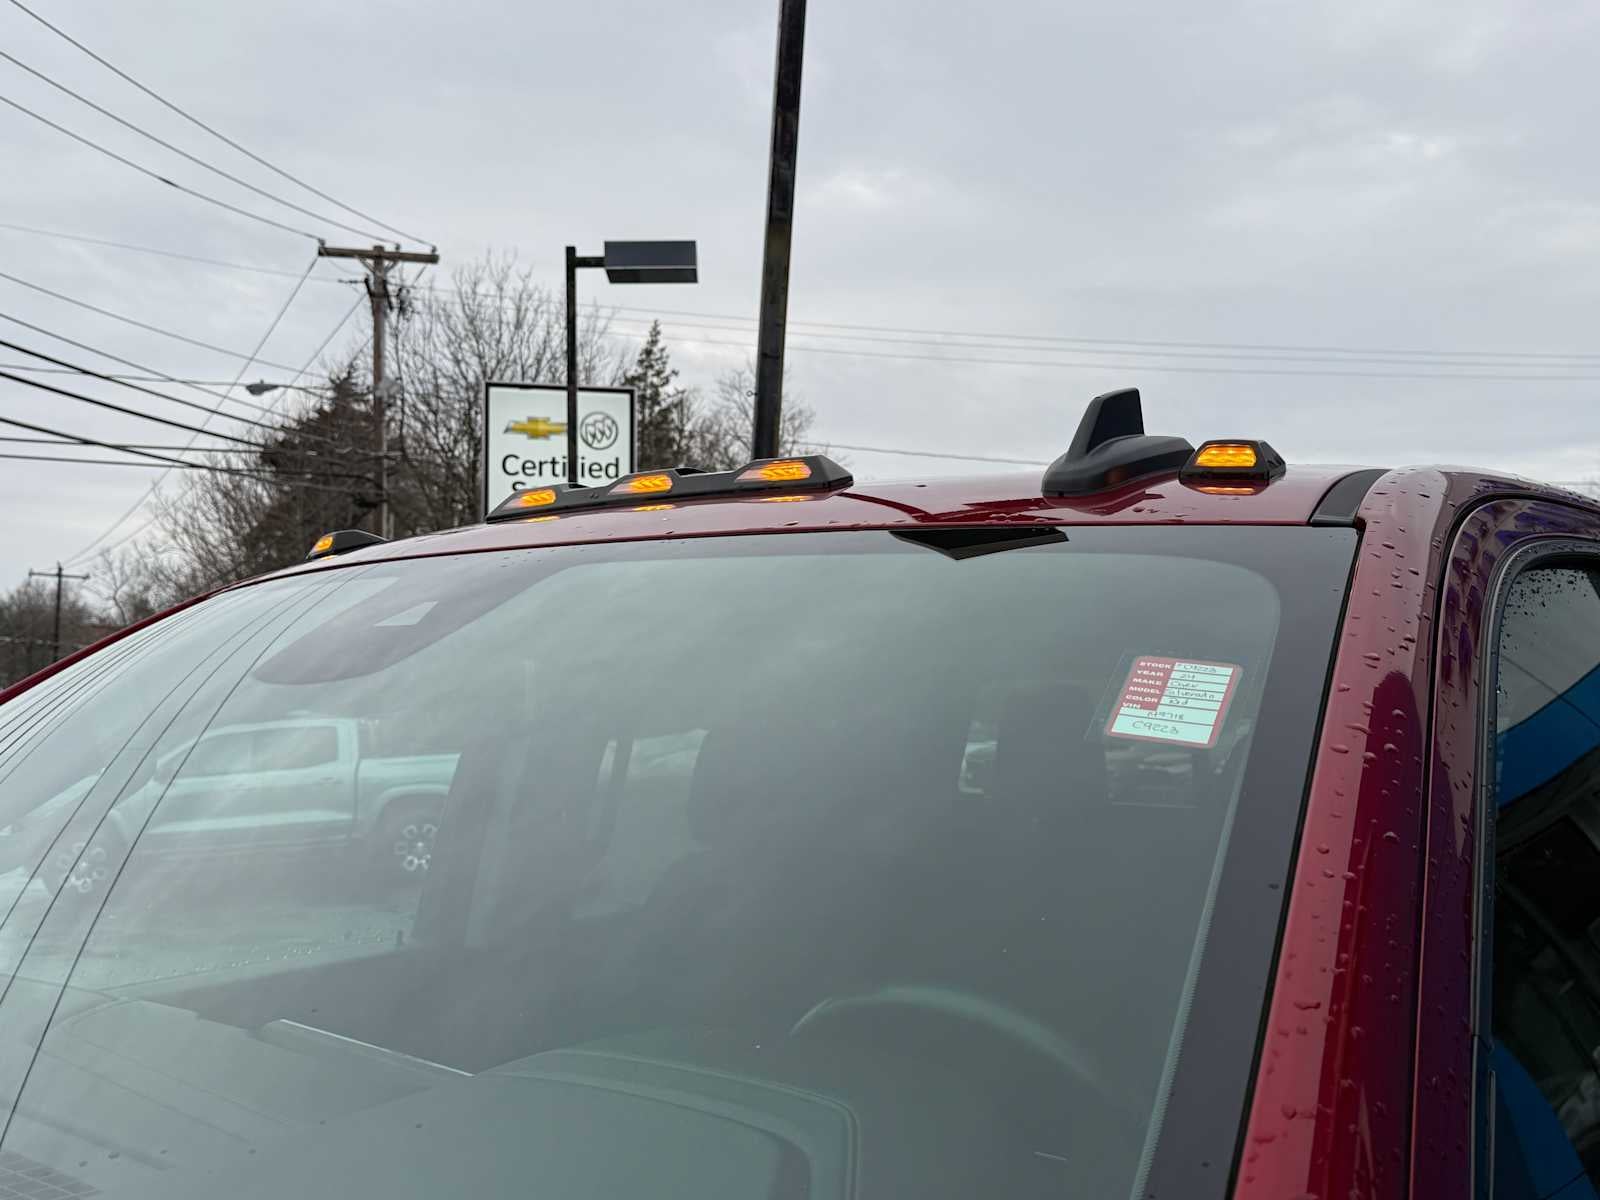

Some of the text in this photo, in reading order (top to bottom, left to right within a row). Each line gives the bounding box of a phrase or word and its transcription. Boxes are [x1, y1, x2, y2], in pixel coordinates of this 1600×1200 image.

[502, 453, 620, 479] Certiied
[1138, 661, 1172, 669] STOCK
[1136, 669, 1164, 677] YEAR
[1132, 677, 1162, 686] MAKE
[1128, 685, 1162, 695] MODEL
[1125, 694, 1158, 703] COLOR
